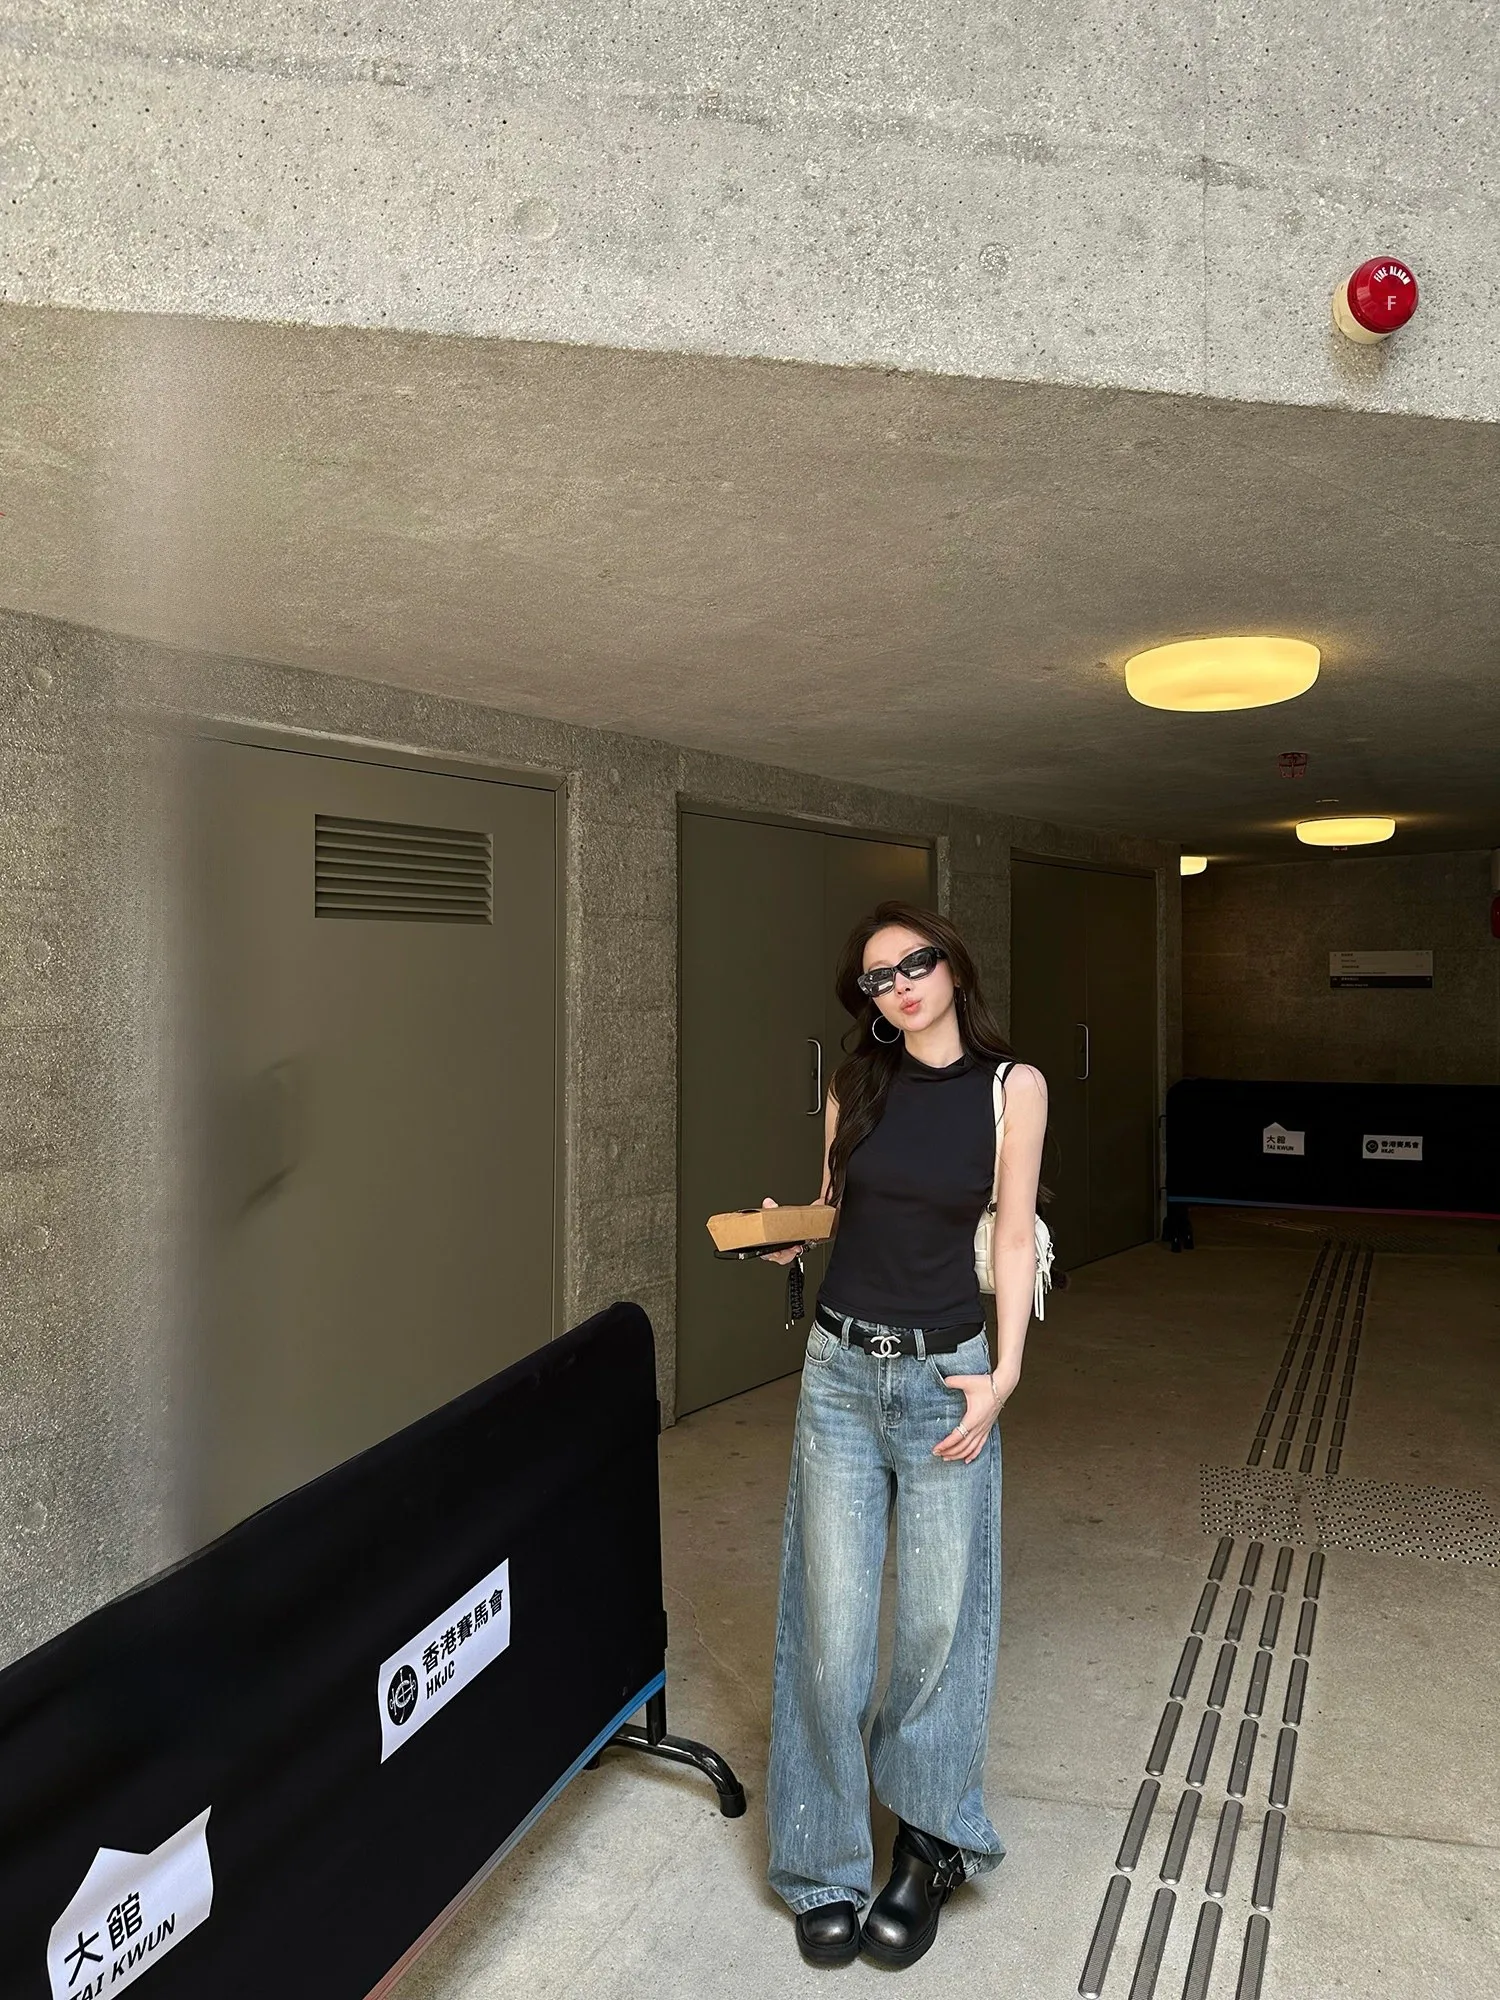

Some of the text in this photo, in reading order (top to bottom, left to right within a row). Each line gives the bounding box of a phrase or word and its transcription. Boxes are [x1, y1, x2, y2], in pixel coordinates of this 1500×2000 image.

[1373, 265, 1411, 285] FIRE ALARM
[1387, 295, 1397, 311] F
[422, 1588, 504, 1675] 香港賽馬會
[426, 1660, 455, 1700] HKJC
[64, 1891, 143, 1987] 大館
[111, 1912, 175, 1983] KWUN
